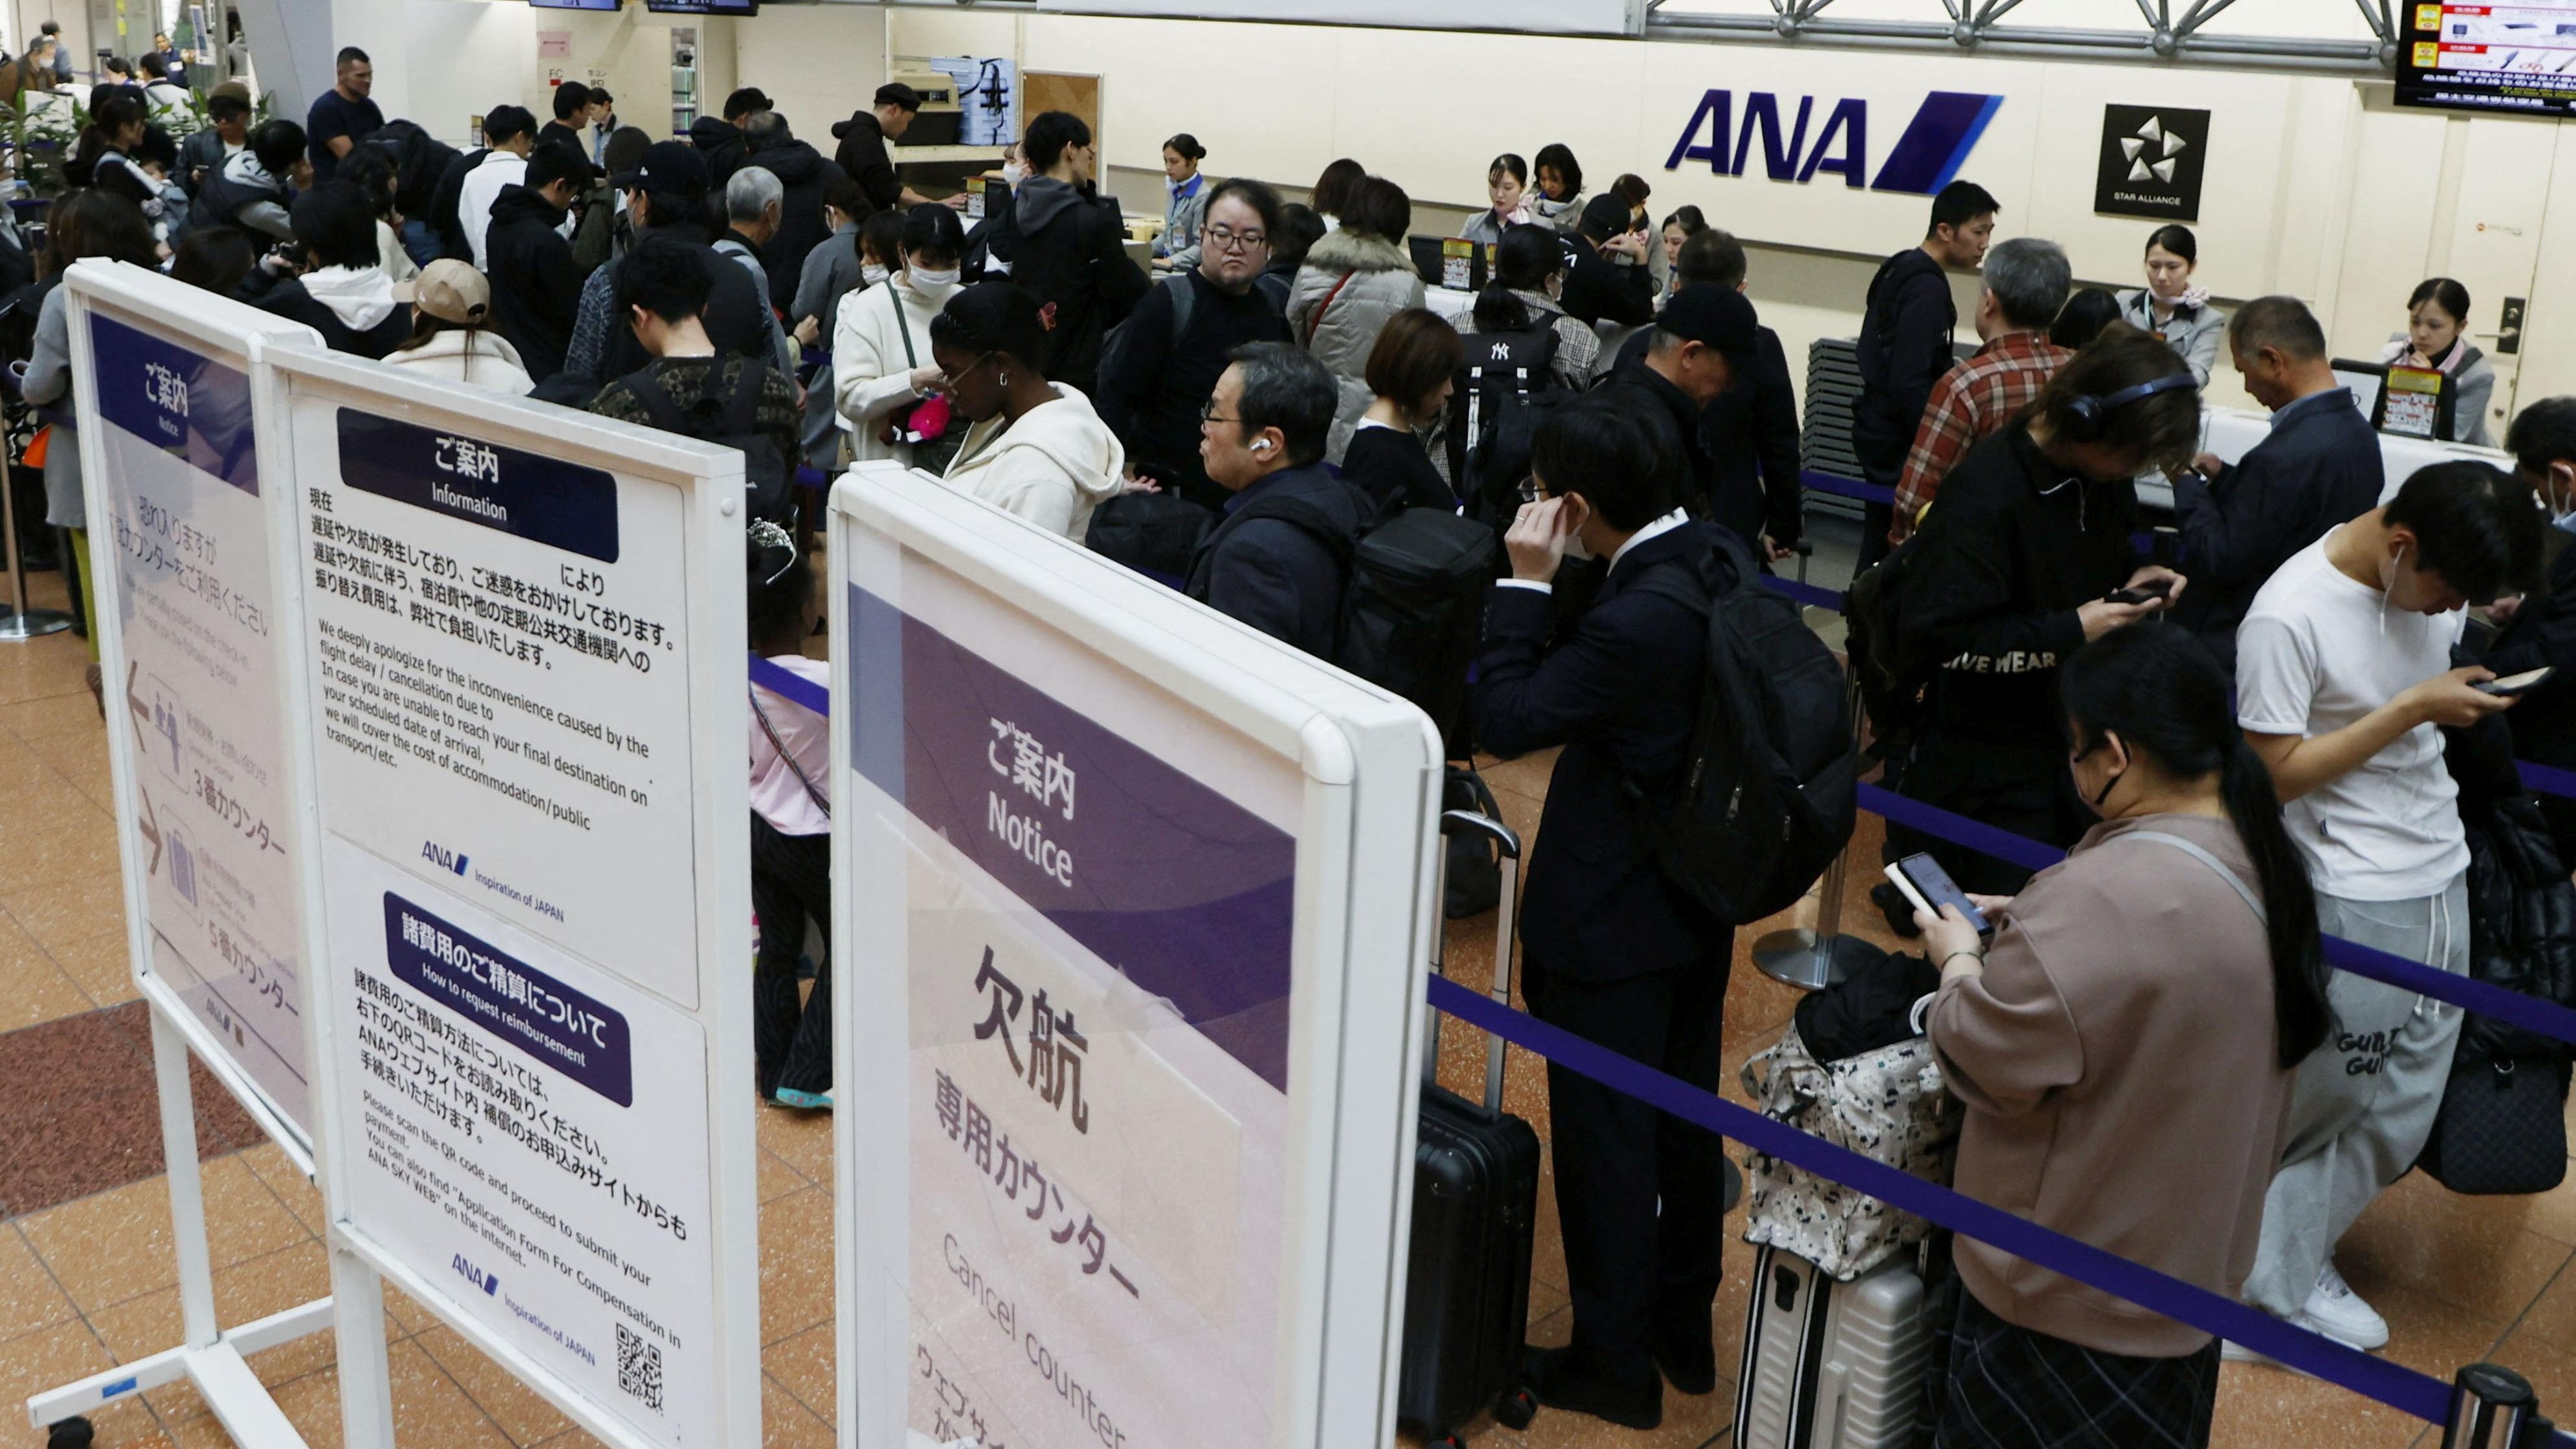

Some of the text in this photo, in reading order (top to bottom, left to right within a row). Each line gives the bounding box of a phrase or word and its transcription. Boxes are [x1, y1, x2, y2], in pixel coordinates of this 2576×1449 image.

[549, 69, 563, 78] FC
[1665, 89, 1866, 188] ANA
[2114, 192, 2181, 206] STAR ALLIANCE
[145, 362, 188, 417] ご案内
[432, 482, 506, 521] Information
[434, 436, 499, 484] ご案内
[310, 488, 604, 596] 現在 により
[312, 515, 673, 651] 遅延や欠航が発生しており、ご迷惑をおかけしております。
[314, 541, 650, 673] 遅延や欠航に伴う、宿泊費や他の定期公共交通機関への
[316, 569, 551, 670] 振り替え費用は、弊社で負担いたします。
[319, 619, 649, 758] We deeply apologize for the inconvenience caused by the
[320, 639, 346, 662] flight
[349, 652, 376, 677] delay
[389, 670, 452, 704] cancellation
[457, 694, 478, 715] due
[481, 703, 493, 721] to
[1996, 650, 2056, 673] WEAR
[322, 661, 647, 806] In case you are unable to reach your final destination on
[324, 686, 484, 765] your scheduled date of arrival,
[325, 707, 590, 830] we will cover the cost of accommodation/public
[327, 725, 397, 767] transport/etc.
[987, 716, 1076, 820] ご案内
[193, 769, 286, 854] 3番カウンター
[422, 840, 452, 871] ANA
[988, 790, 1073, 887] Notice
[476, 869, 564, 923] Inspiration of JAPAN
[401, 911, 606, 1049] 諸費用のご精算について
[423, 963, 586, 1067] How to request reimbursement
[354, 967, 549, 1102] 諸費用のご精算方法については、
[356, 997, 608, 1165] 右下のQRコードをお読み取りください。
[973, 945, 1089, 1135] 欠航
[358, 1024, 687, 1241] ANAウェブサイト内 補償のお申込みサイトからも
[360, 1052, 483, 1144] 手続きいただけます。
[365, 1111, 409, 1148] payment.
[364, 1090, 650, 1286] Please scan the QR code and proceed to submit your
[369, 1148, 388, 1170] ANA
[391, 1163, 410, 1184] SKY
[445, 1203, 457, 1218] on
[461, 1211, 478, 1233] the
[482, 1224, 526, 1267] internet.
[934, 1068, 1140, 1299] 専用カウンター
[367, 1128, 384, 1149] You
[388, 1145, 404, 1163] can
[407, 1159, 427, 1179] also
[430, 1172, 449, 1194] find
[520, 1233, 549, 1263] Form
[554, 1255, 573, 1276] For
[577, 1270, 664, 1338] Compensation
[669, 1330, 680, 1348] in
[452, 1253, 482, 1289] ANA
[505, 1294, 595, 1366] Inspiration of JAPAN
[944, 1233, 1126, 1449] Cancel counter
